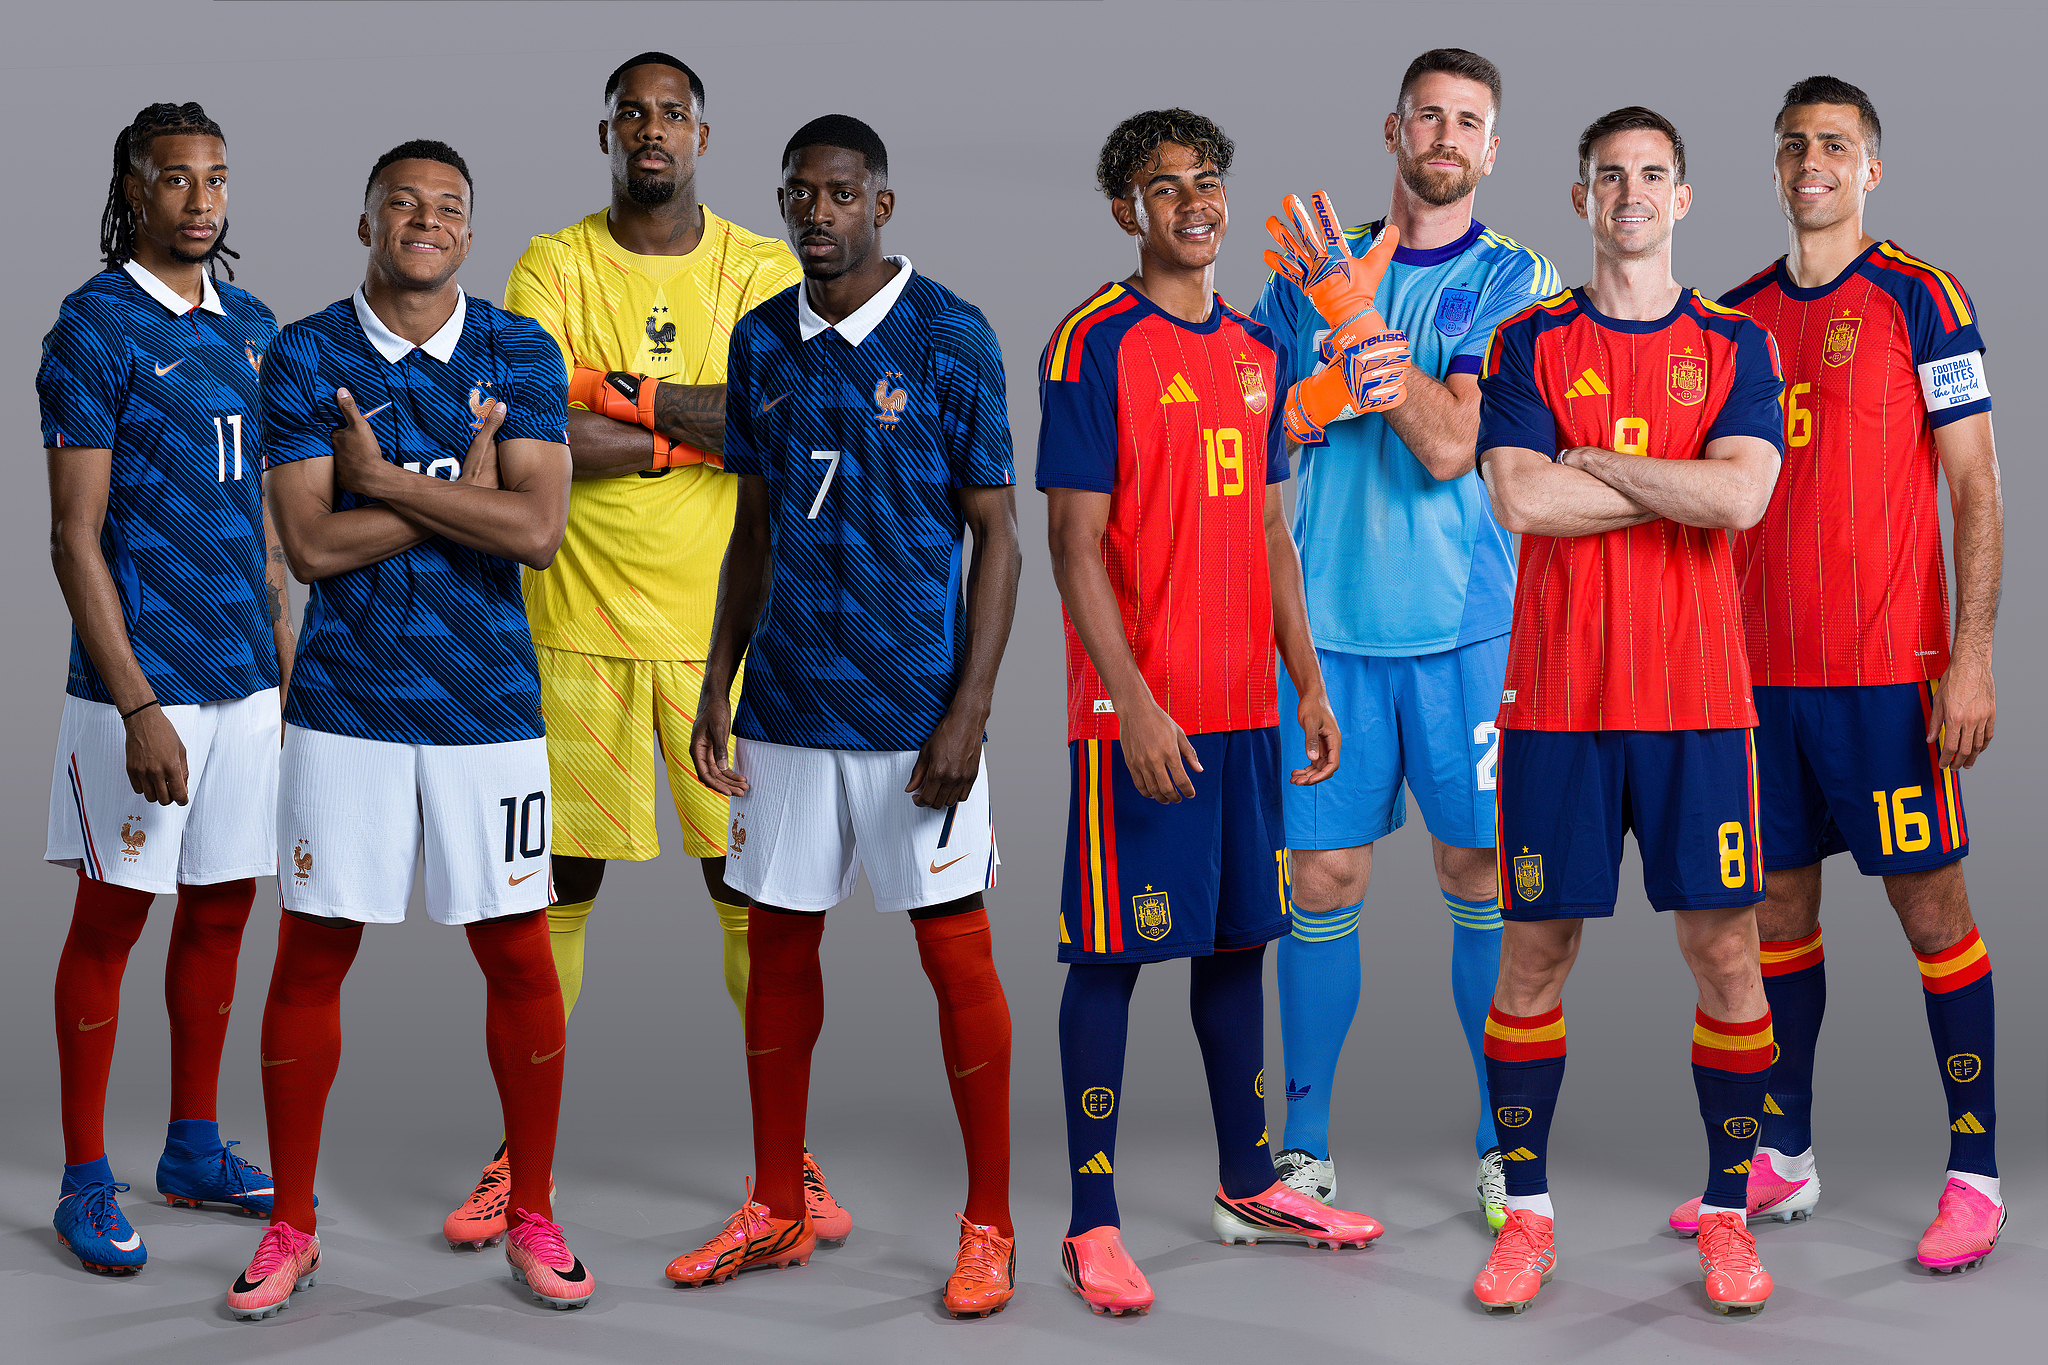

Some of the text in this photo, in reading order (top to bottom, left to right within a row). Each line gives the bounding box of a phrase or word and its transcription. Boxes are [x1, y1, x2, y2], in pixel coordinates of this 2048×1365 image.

[1312, 194, 1340, 246] reusch
[1360, 331, 1409, 350] reusch
[1931, 357, 1972, 376] FOOTBALL
[1931, 378, 1979, 399] the World
[1933, 366, 1975, 388] UNITES
[213, 414, 243, 483] 11
[1778, 382, 1812, 448] 6
[807, 450, 841, 520] 7
[1203, 427, 1244, 497] 19
[500, 790, 546, 863] 10
[1872, 785, 1931, 856] 16
[1717, 821, 1746, 889] 8
